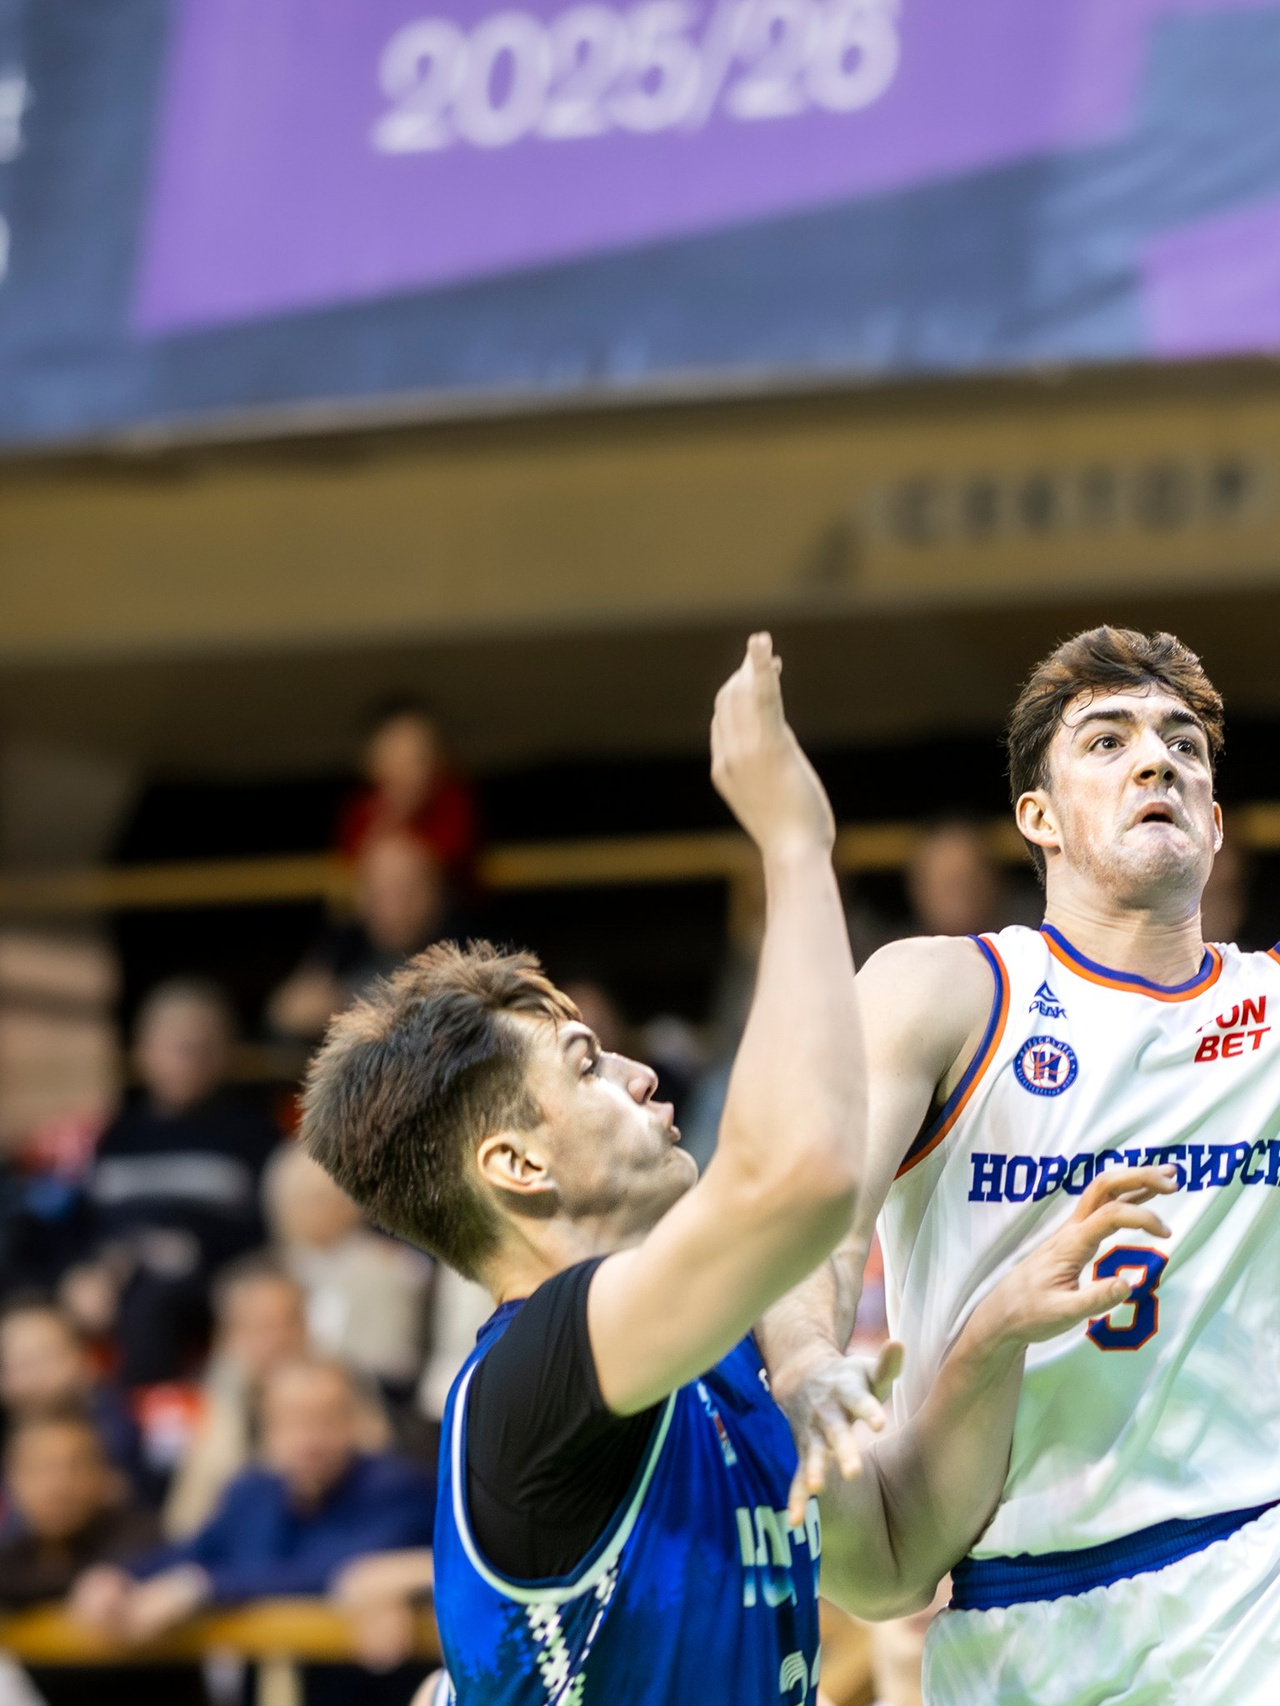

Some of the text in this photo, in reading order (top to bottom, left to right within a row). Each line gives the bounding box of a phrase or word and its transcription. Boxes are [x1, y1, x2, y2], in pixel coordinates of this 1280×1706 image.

[371, 0, 898, 153] 2025/26
[1028, 1000, 1068, 1019] PEAK
[1194, 1026, 1272, 1063] BET
[1086, 1245, 1169, 1351] 3
